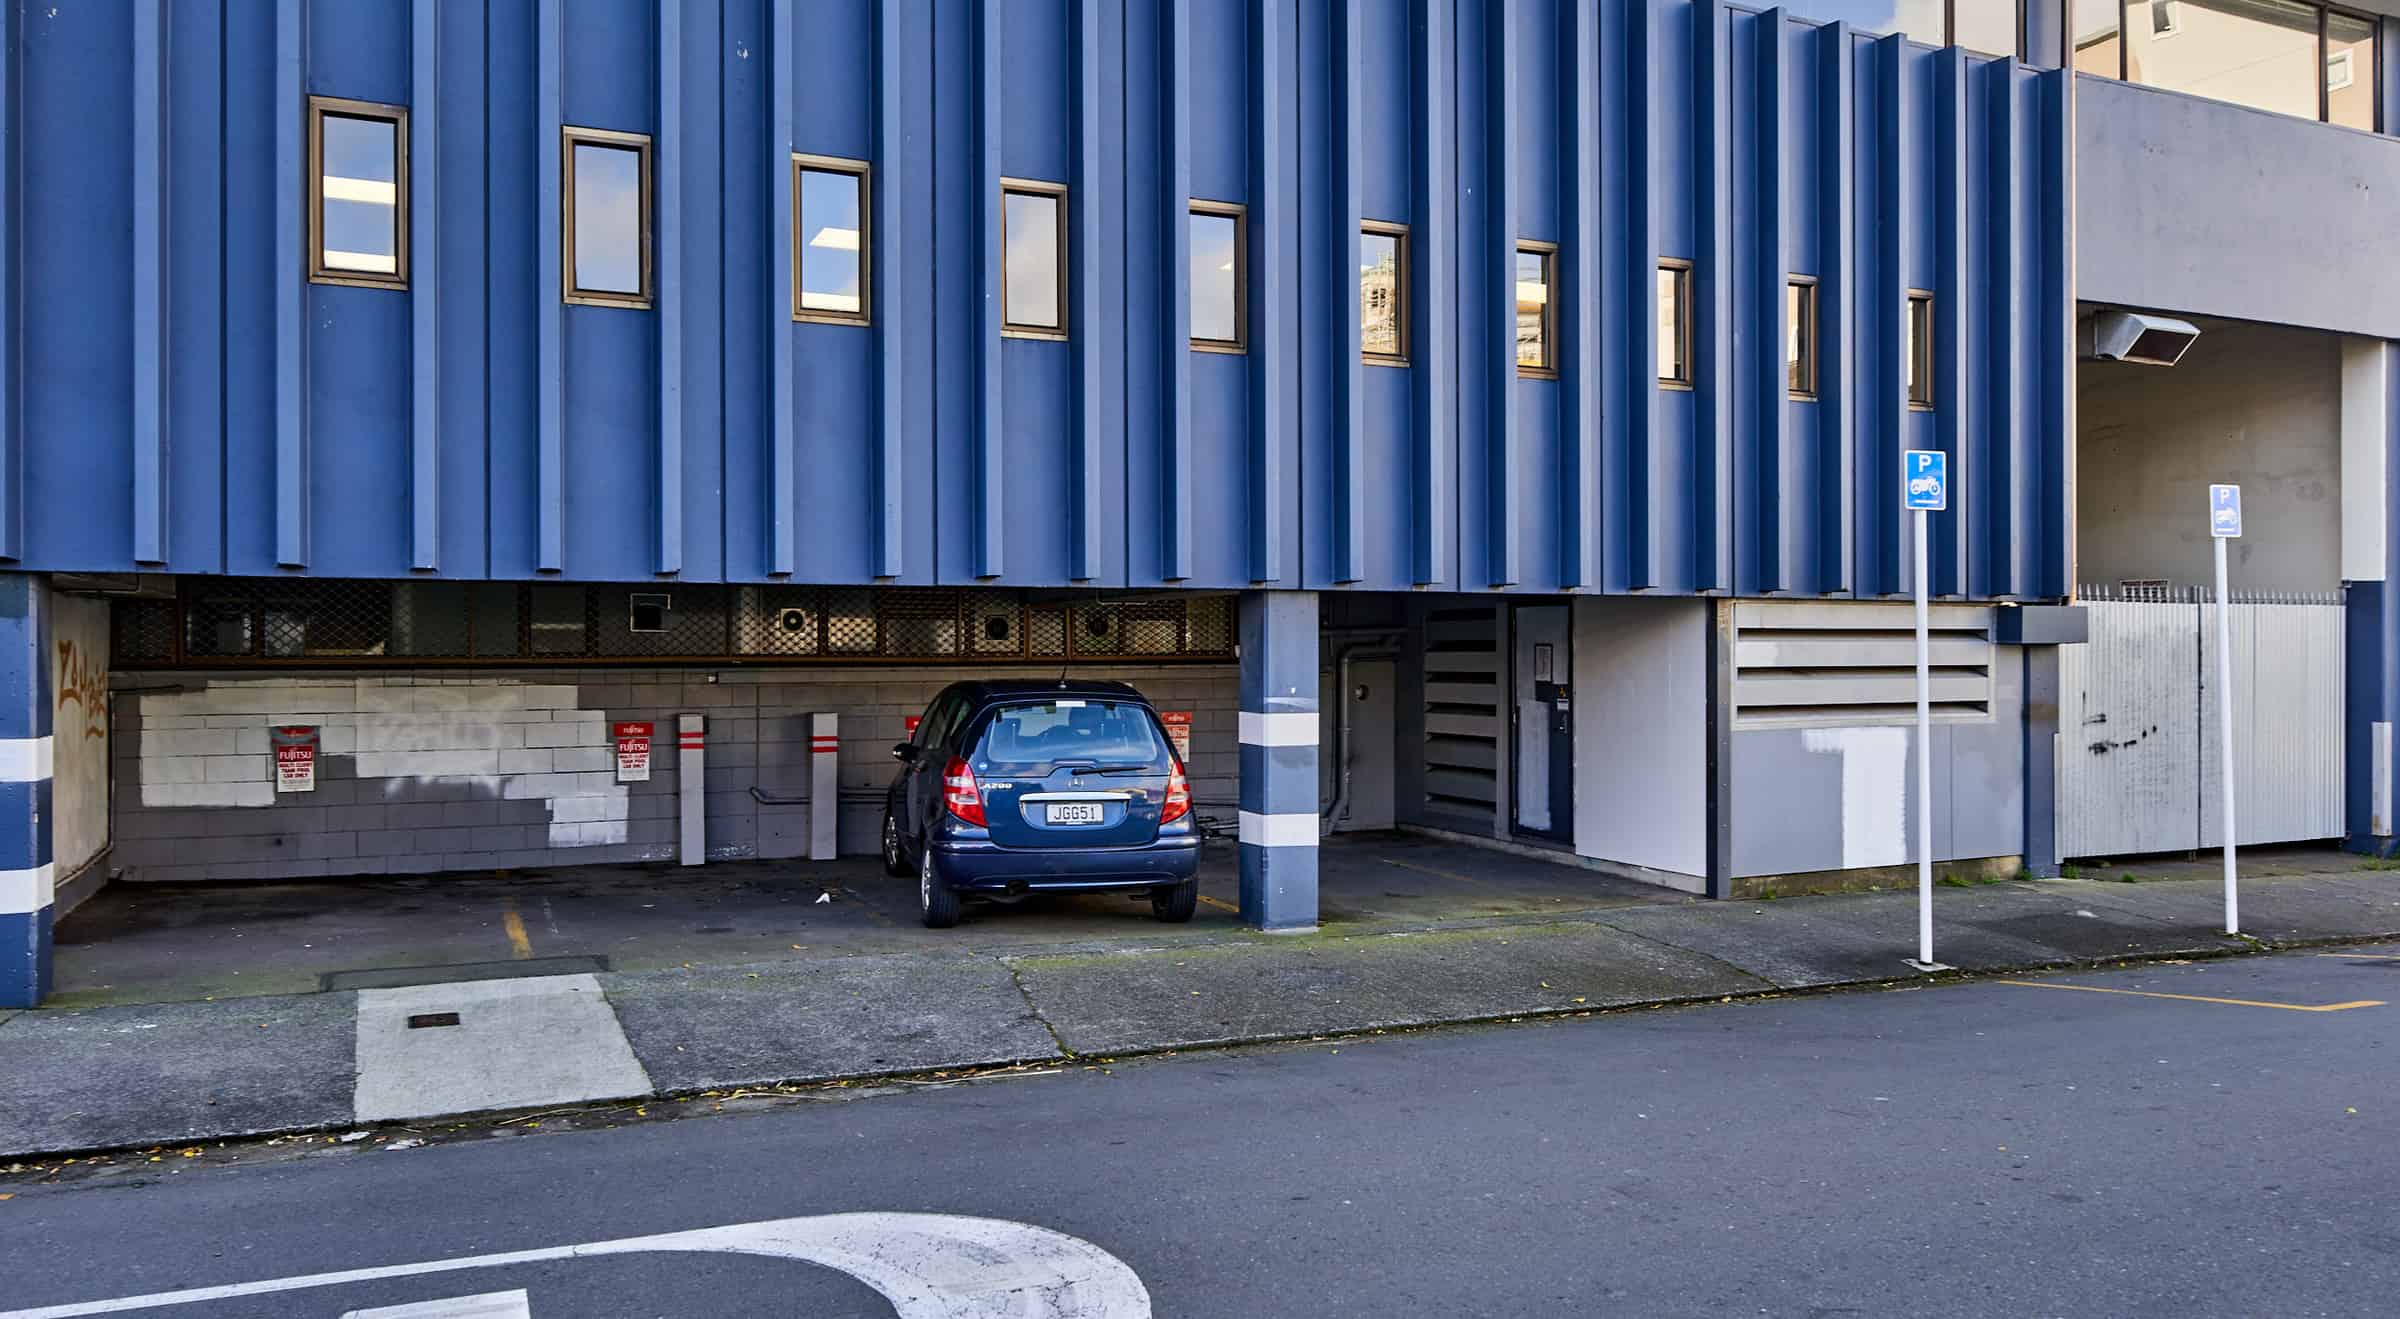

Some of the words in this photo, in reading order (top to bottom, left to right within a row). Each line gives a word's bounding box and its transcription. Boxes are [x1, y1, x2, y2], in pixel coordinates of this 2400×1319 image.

[1919, 454, 1932, 473] P
[2220, 488, 2230, 505] P
[620, 741, 648, 752] FUJITSU
[280, 748, 312, 760] FUJITSU
[1054, 806, 1095, 820] JGG51
